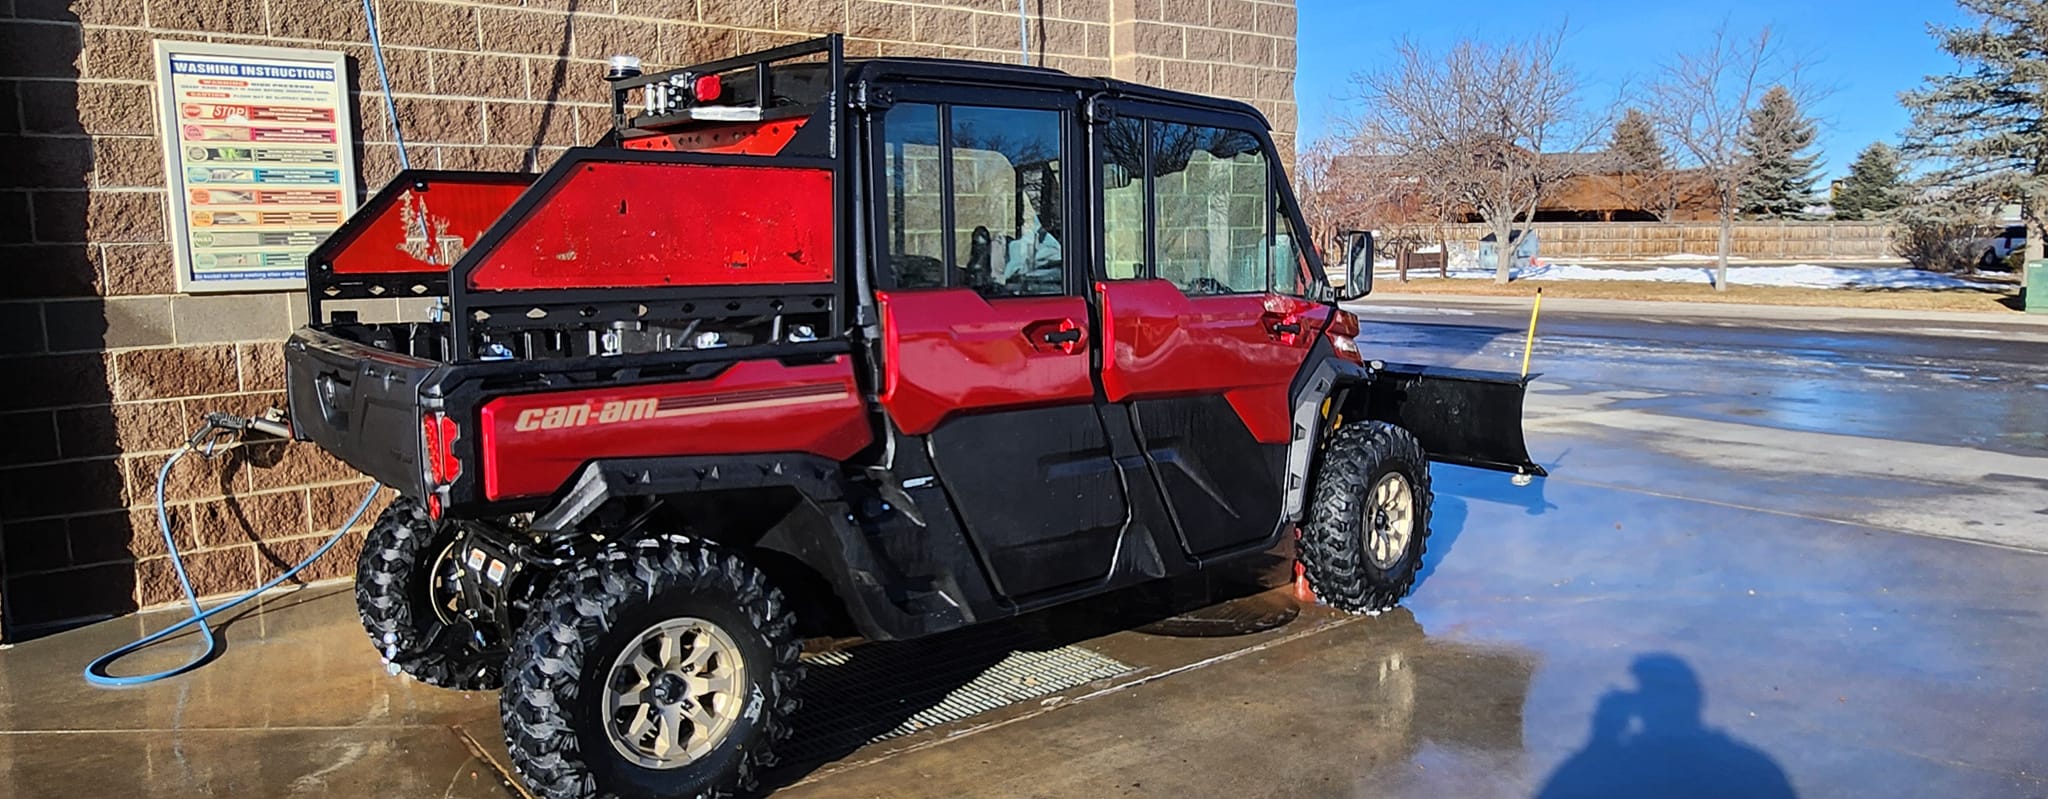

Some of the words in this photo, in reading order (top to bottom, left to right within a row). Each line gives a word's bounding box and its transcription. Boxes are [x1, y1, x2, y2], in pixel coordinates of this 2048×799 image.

[173, 62, 239, 76] WASHING
[240, 66, 334, 80] INSTRUCTIONS
[214, 105, 245, 117] STOP
[514, 398, 659, 432] can-am
